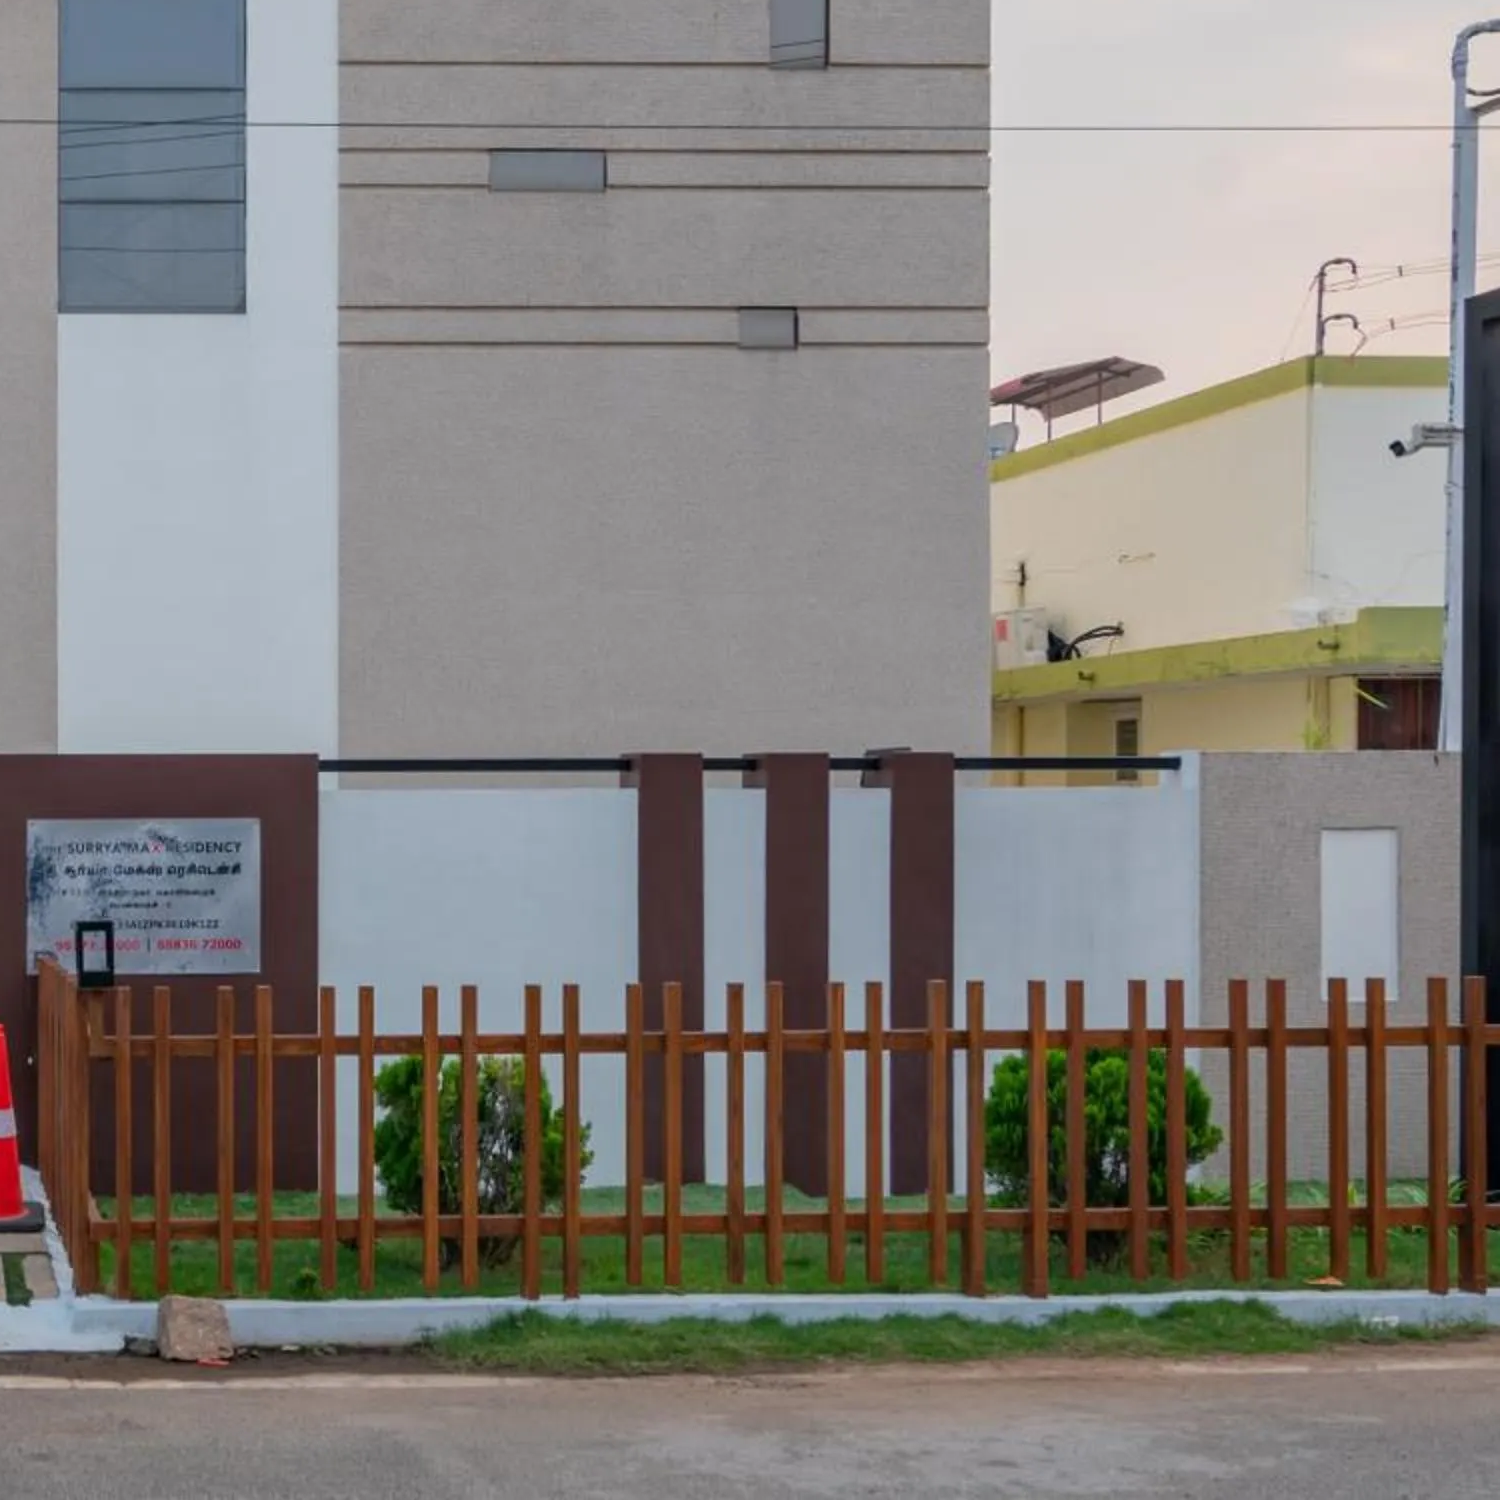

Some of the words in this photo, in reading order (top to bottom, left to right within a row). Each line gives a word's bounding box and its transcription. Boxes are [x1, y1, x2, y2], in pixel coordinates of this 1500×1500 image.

[67, 841, 121, 855] SURRYA
[122, 841, 164, 855] MAX
[165, 841, 242, 854] RESIDENCY
